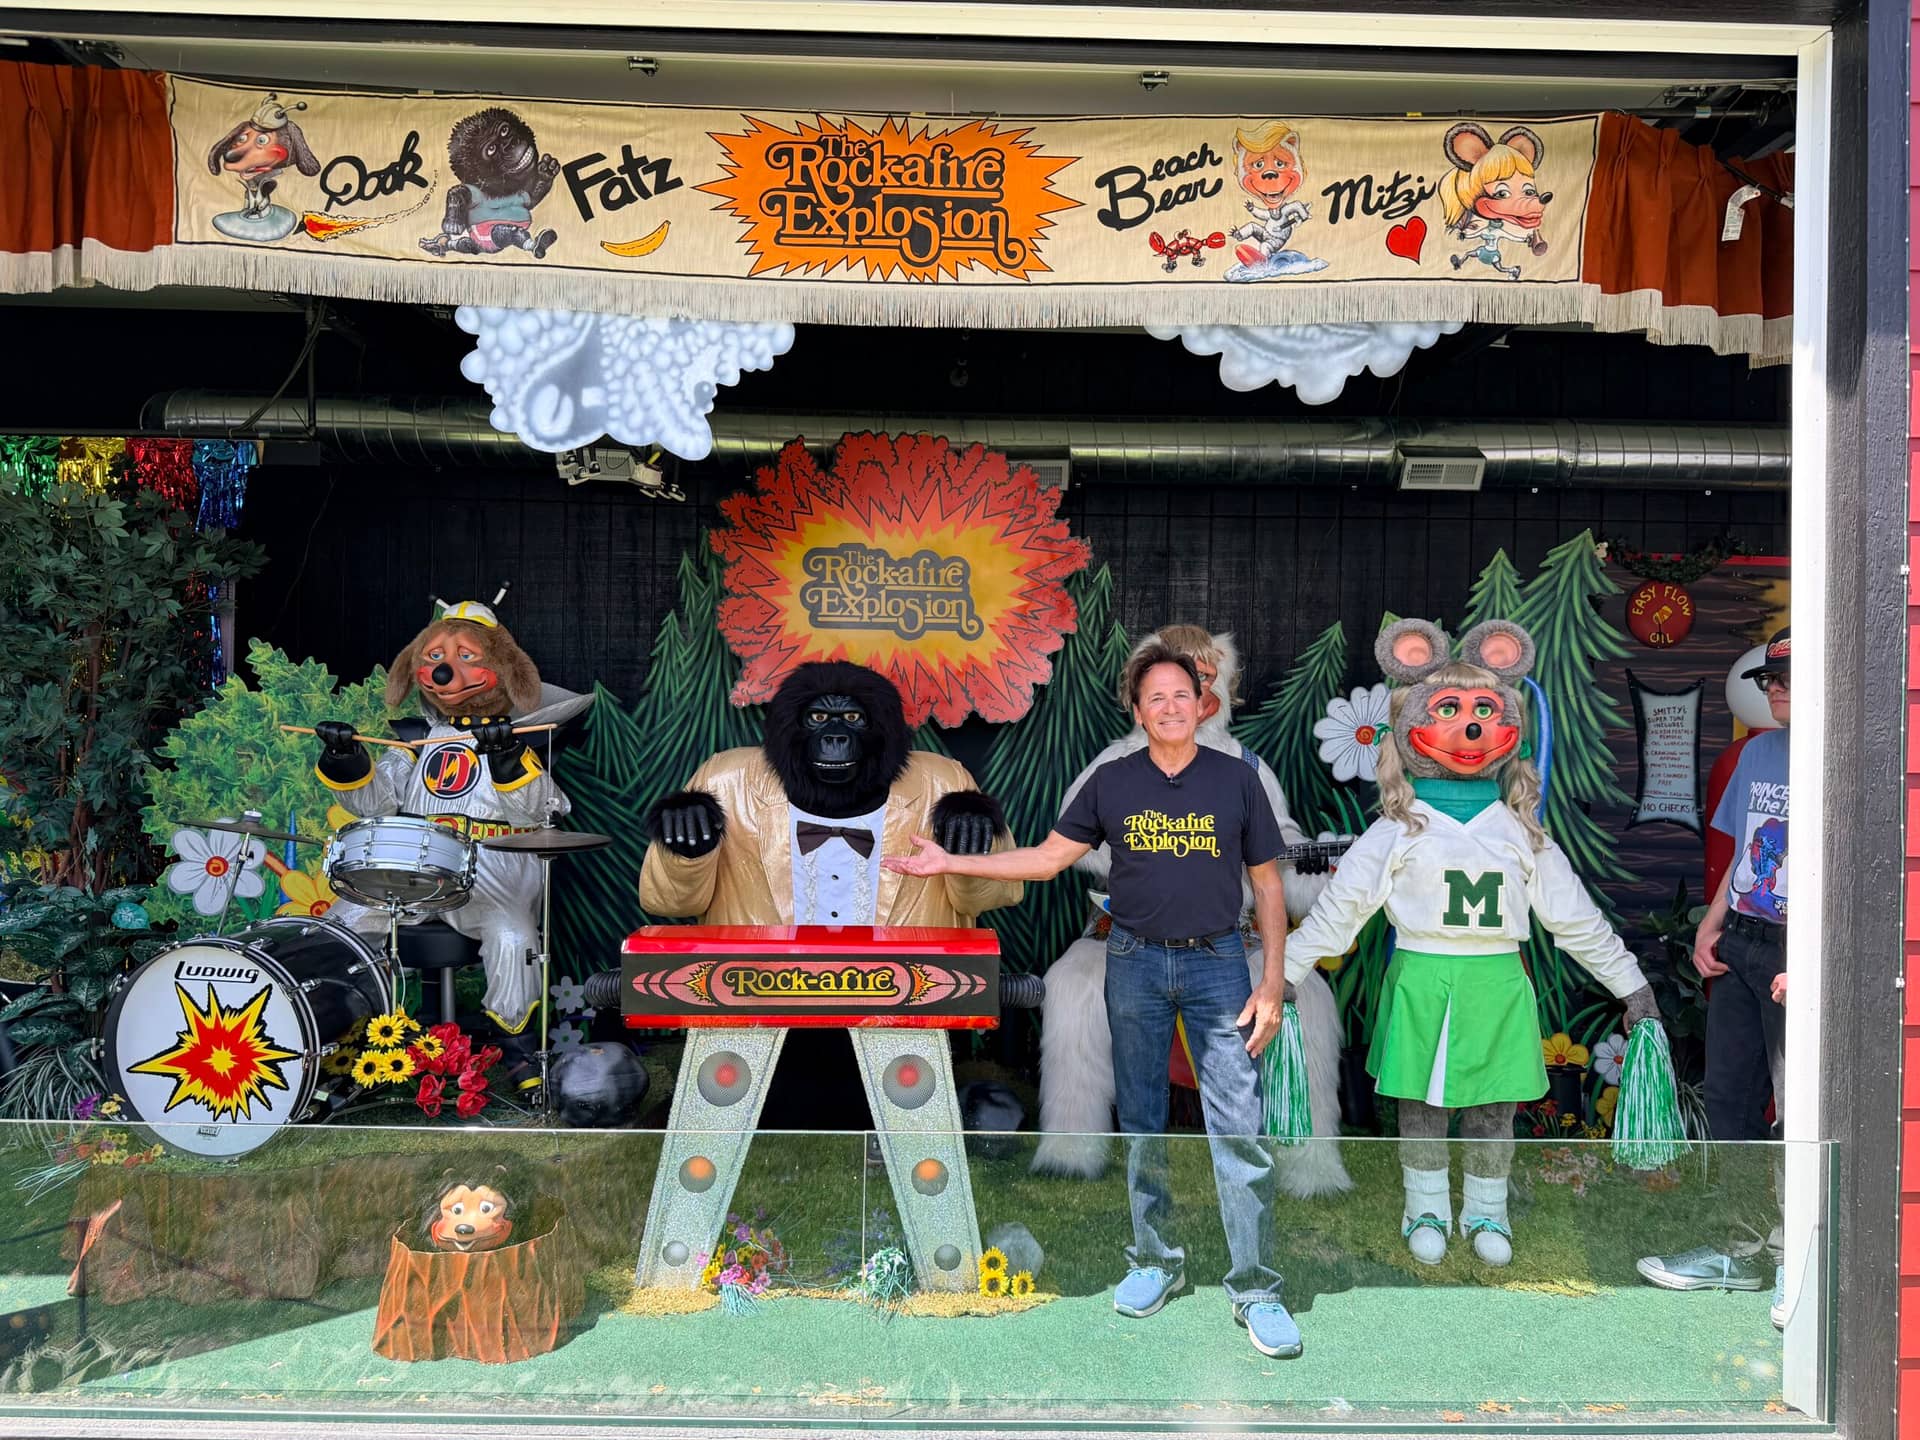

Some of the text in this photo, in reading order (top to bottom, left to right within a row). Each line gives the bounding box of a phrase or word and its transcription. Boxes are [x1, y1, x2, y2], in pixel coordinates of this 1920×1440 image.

[820, 135, 866, 158] The
[562, 144, 685, 222] Fatz
[768, 143, 1004, 204] Rock-afire
[1095, 143, 1223, 228] Beach
[1095, 166, 1223, 231] Bear
[1321, 170, 1439, 224] Mitzi
[761, 192, 1026, 266] Explosion
[809, 555, 964, 598] Rock-afire
[844, 550, 875, 565] The
[806, 589, 980, 634] Explosion
[1632, 585, 1691, 616] EASY FLOW
[1649, 632, 1674, 644] OIL
[434, 751, 471, 792] D
[1142, 809, 1162, 819] The
[1123, 831, 1221, 858] Explosion
[1442, 869, 1504, 928] M
[725, 968, 899, 996] Rock-afire
